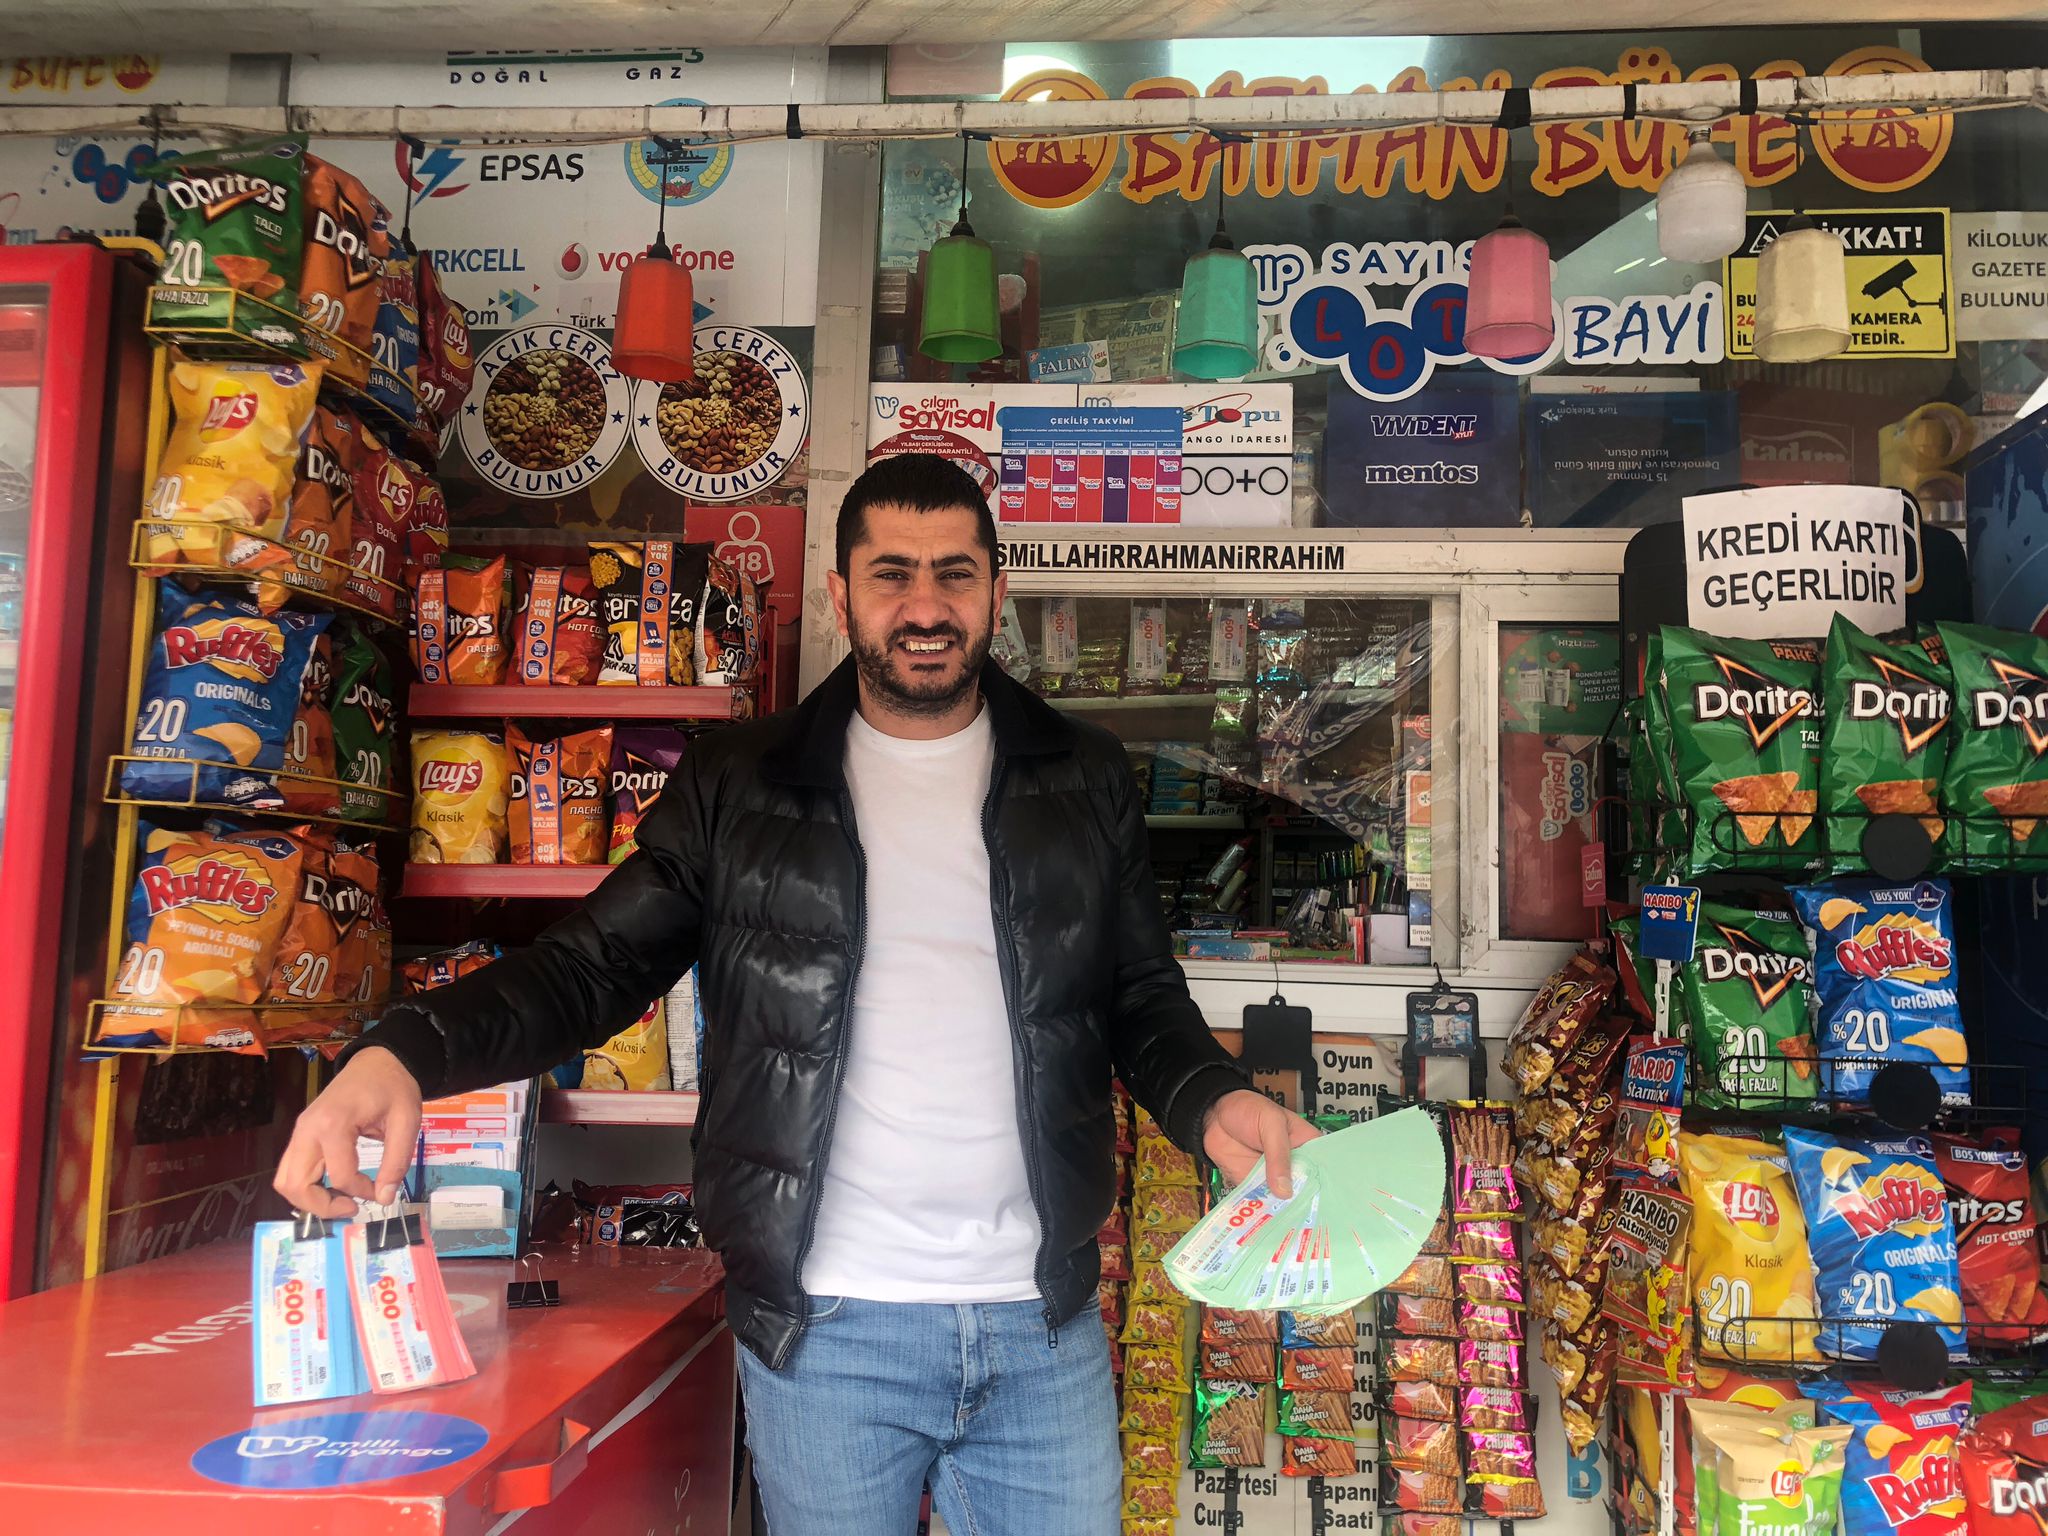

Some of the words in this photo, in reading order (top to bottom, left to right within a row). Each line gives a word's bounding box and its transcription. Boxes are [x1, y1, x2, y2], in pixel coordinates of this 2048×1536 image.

[449, 67, 549, 84] DOĞAL
[625, 66, 683, 81] GAZ
[1531, 47, 1806, 197] BÜE
[480, 153, 585, 182] EPSAŞ
[168, 173, 288, 212] Doritos
[163, 239, 204, 287] 20
[433, 249, 525, 273] RKCELL
[598, 244, 735, 272] vofone
[1972, 261, 2046, 278] GAZETE
[1961, 293, 2048, 309] BULUNU
[570, 314, 606, 328] Türk
[1571, 292, 1714, 359] BAYİ
[1851, 313, 1923, 326] KAMERA
[481, 331, 538, 378] AÇIK
[549, 330, 622, 386] ÇEREZ
[713, 330, 793, 381] ÇEREZ
[1038, 354, 1090, 377] FALIM
[920, 395, 960, 412] çılgın
[1557, 406, 1596, 415] Telekom
[1598, 406, 1618, 415] Türk
[898, 401, 996, 432] Sayısal
[1050, 416, 1089, 427] ÇEKİLİŞ
[1091, 415, 1135, 426] TAKVİMİ
[1230, 434, 1288, 444] İDARESİ
[1640, 448, 1669, 458] kutlu
[477, 447, 603, 492] BULUNUR
[657, 450, 786, 496] BULUNUR
[1365, 461, 1478, 484] mentos
[1554, 460, 1584, 470] Günü
[1586, 460, 1615, 470] Birlik
[1645, 460, 1658, 468] ve
[1660, 460, 1720, 470] Demokrasi
[1606, 472, 1655, 482] Temmuz
[1655, 472, 1668, 482] 15
[1697, 511, 1799, 562] KREDİ
[1810, 519, 1899, 557] KARTI
[650, 551, 668, 561] YOK
[722, 552, 762, 572] +18
[996, 543, 1345, 570] SMiLLAHiRRAHMANiRRAHiM
[1703, 560, 1897, 612] GEÇERLİDİR
[568, 622, 588, 632] HOT
[163, 623, 286, 679] Ruffles
[194, 681, 272, 711] ORIGINALS
[1852, 682, 1952, 719] Dorit
[420, 759, 480, 794] Lay's
[612, 770, 669, 792] Dorit
[426, 810, 465, 824] Klasik
[140, 859, 279, 917] Ruffles
[1873, 889, 1894, 903] BOŞ
[1894, 888, 1913, 902] YOK!
[1643, 893, 1684, 909] HARIBO
[208, 929, 224, 942] VE
[1835, 924, 1953, 981] Ruffles
[1833, 1009, 1890, 1053] %20
[611, 1040, 647, 1055] Klasik
[1717, 1025, 1768, 1074] %20
[1323, 1050, 1373, 1073] Oyun
[1627, 1054, 1676, 1084] HARIBO
[1747, 1076, 1779, 1093] FAZLA
[1954, 1149, 1973, 1161] BOŞ
[1974, 1150, 1998, 1162] YOK!
[1228, 1199, 1264, 1229] 600
[1621, 1189, 1679, 1237] HARIBO
[1835, 1176, 1948, 1242] Ruffles
[1617, 1215, 1646, 1241] Altın
[1644, 1227, 1669, 1255] Ayıcık
[1976, 1234, 1999, 1246] HOT
[2001, 1228, 2035, 1241] CORN
[1744, 1253, 1784, 1269] Klasik
[283, 1278, 305, 1326] 600
[378, 1275, 401, 1320] 600
[1699, 1276, 1752, 1326] %20
[1840, 1271, 1897, 1317] %20
[1213, 1319, 1235, 1328] DAHA
[1209, 1352, 1231, 1362] DAHA
[1296, 1364, 1318, 1374] DAHA
[1289, 1411, 1329, 1423] BAHARATLI
[1292, 1405, 1315, 1415] DAHA
[1915, 1414, 1934, 1427] BOŞ
[314, 1446, 453, 1459] piyango
[1201, 1446, 1241, 1456] BAHARATLI
[1205, 1439, 1228, 1449] DAHA
[1294, 1445, 1316, 1456] DAHA
[1194, 1470, 1278, 1496] Pazrtesi
[1323, 1508, 1374, 1530] Saati
